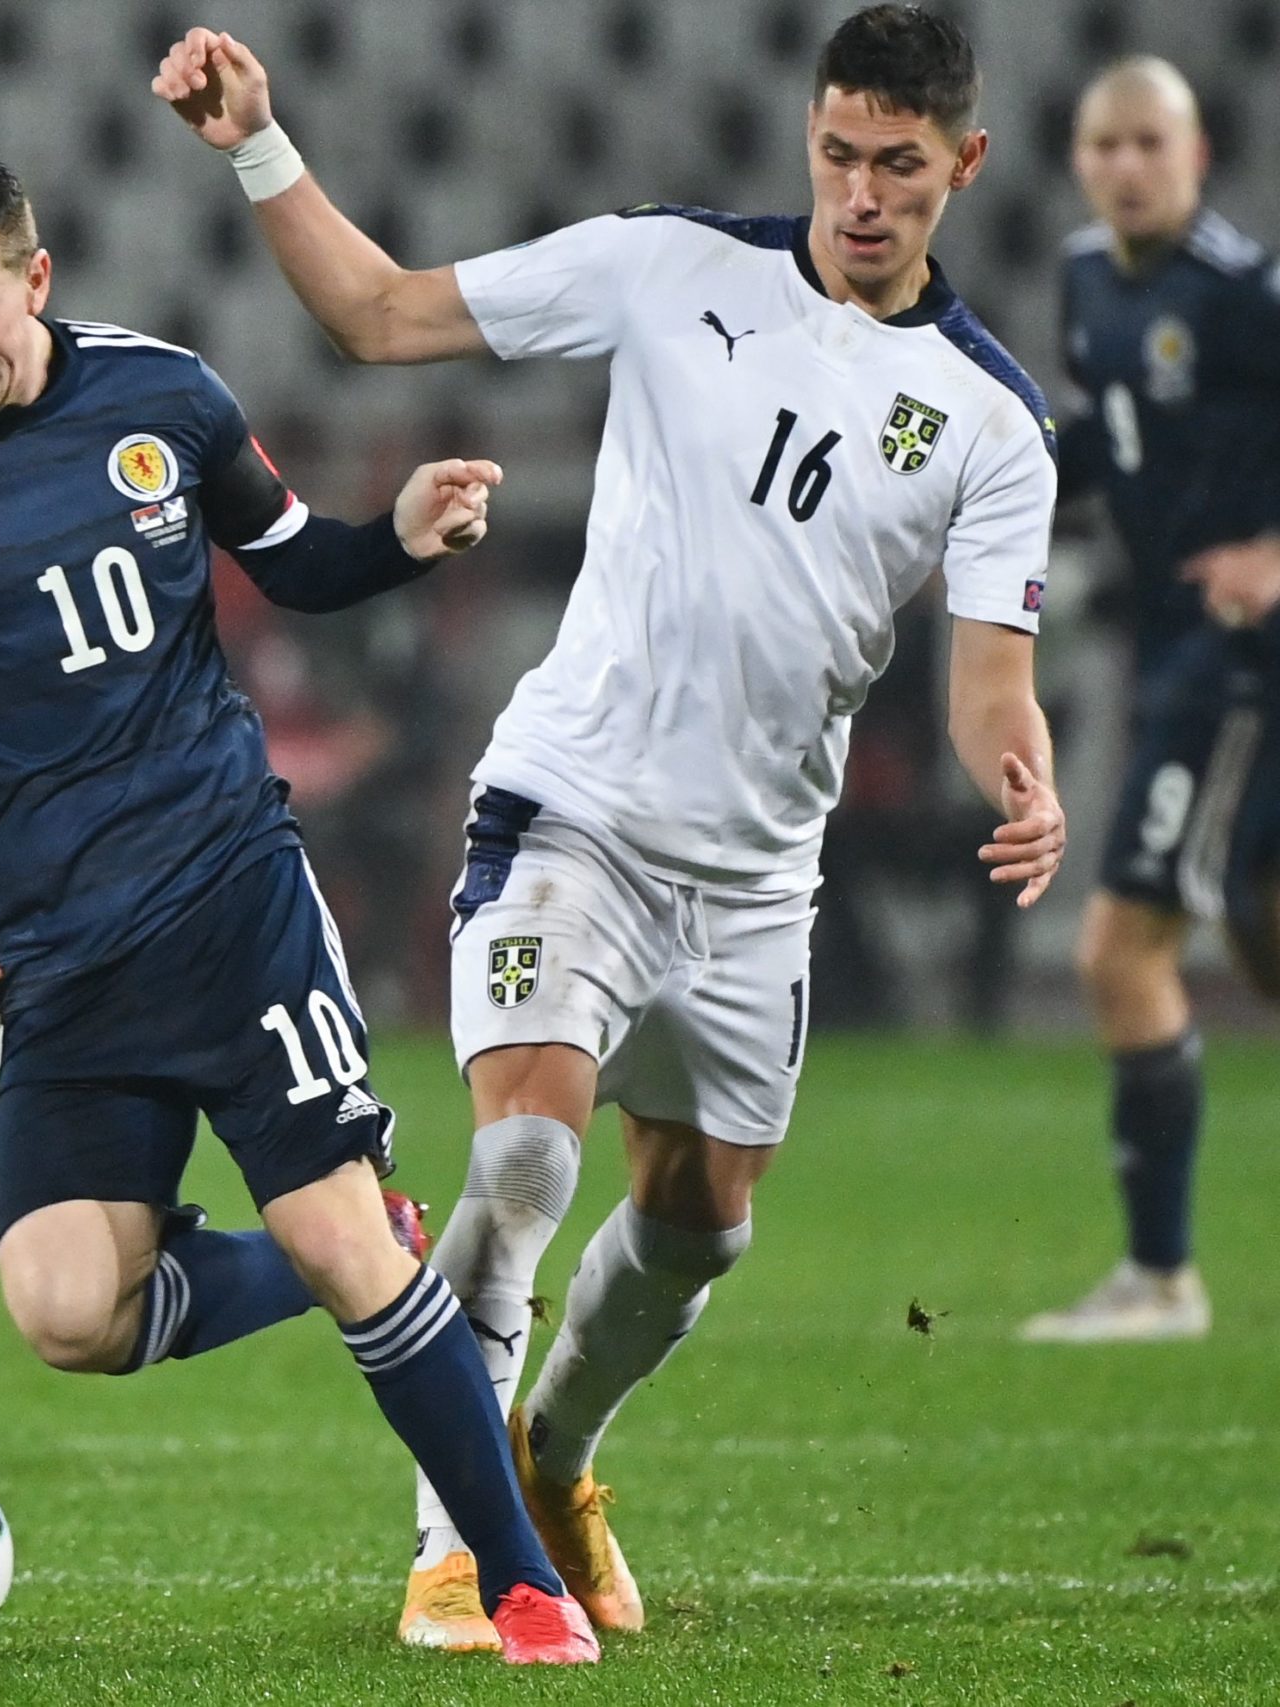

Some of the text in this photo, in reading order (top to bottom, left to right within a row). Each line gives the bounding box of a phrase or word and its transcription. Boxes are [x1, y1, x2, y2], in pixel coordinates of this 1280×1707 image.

[750, 407, 843, 523] 16
[37, 546, 155, 673] 10
[260, 989, 368, 1105] 10
